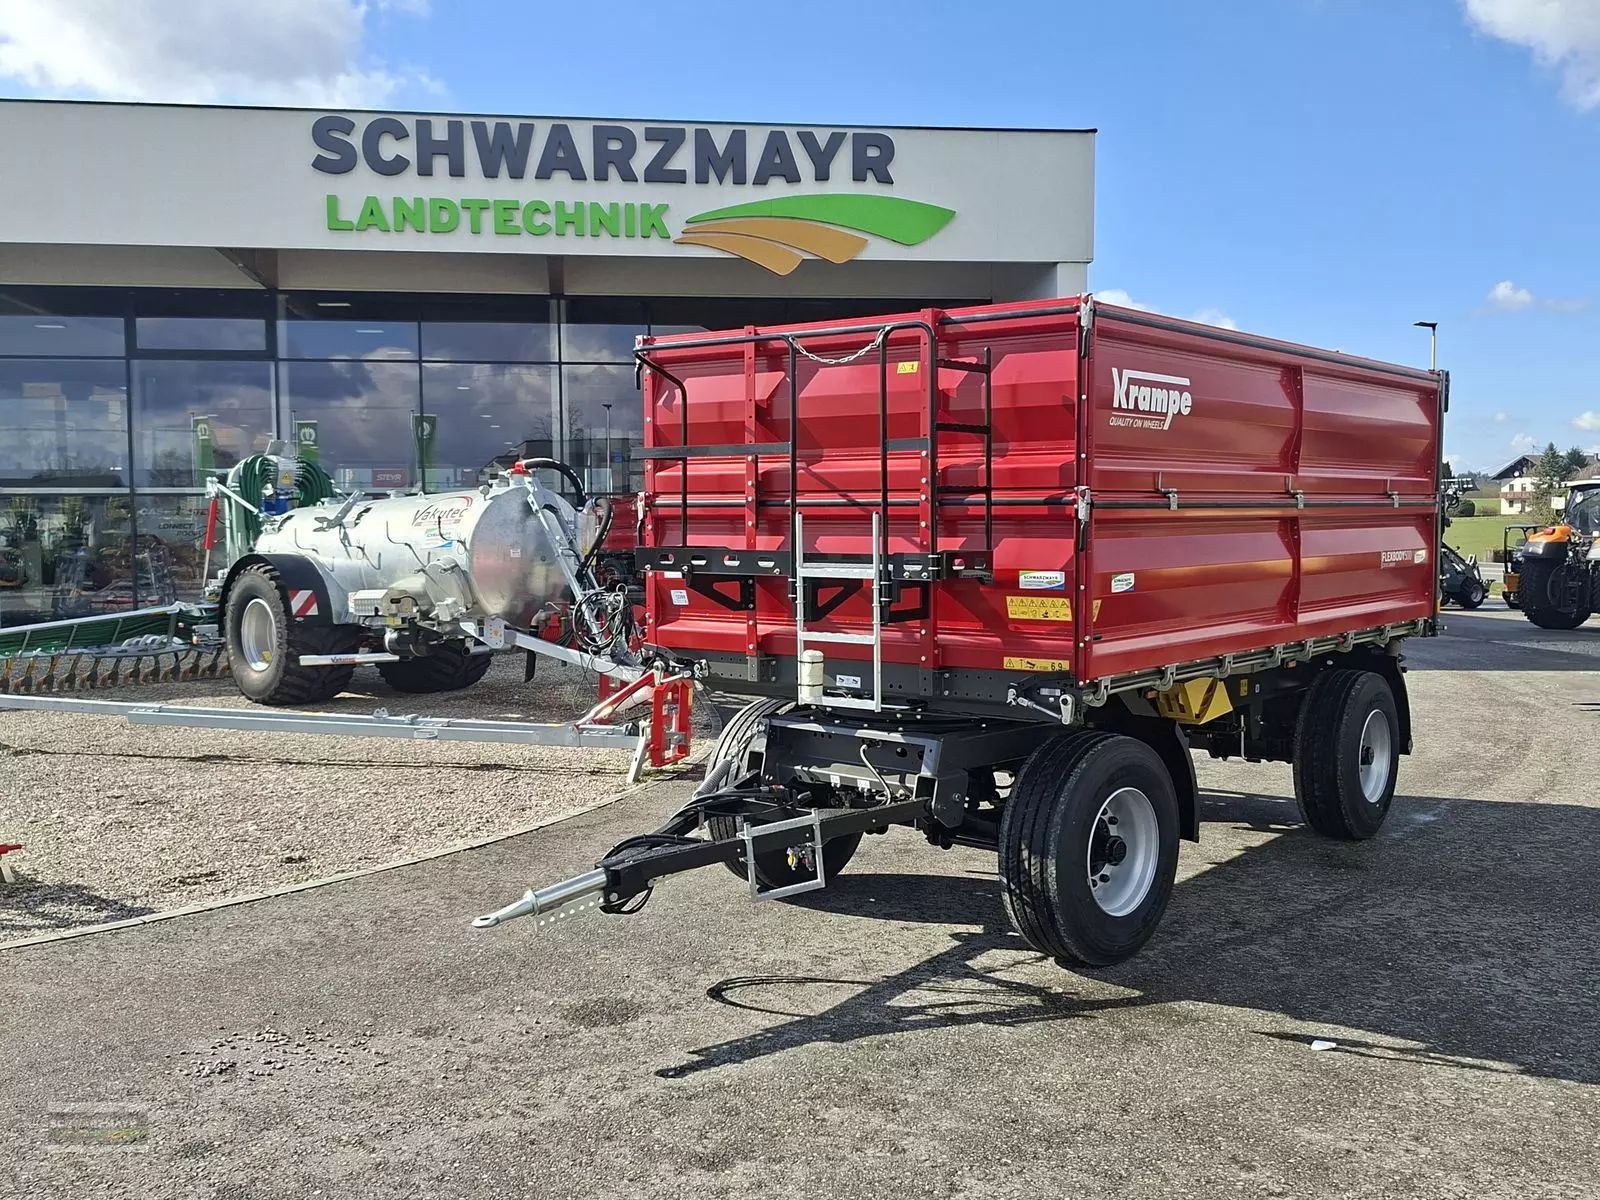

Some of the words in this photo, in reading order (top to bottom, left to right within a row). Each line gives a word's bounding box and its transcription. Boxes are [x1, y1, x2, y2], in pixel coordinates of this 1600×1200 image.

[310, 115, 895, 186] SCHWARZMAYR
[326, 194, 672, 240] LANDTECHNIK
[1111, 367, 1192, 430] Krampe
[1109, 416, 1133, 427] QUALITY
[1133, 418, 1143, 428] ON
[1143, 419, 1165, 430] WHEELS
[411, 504, 469, 527] Vakutec
